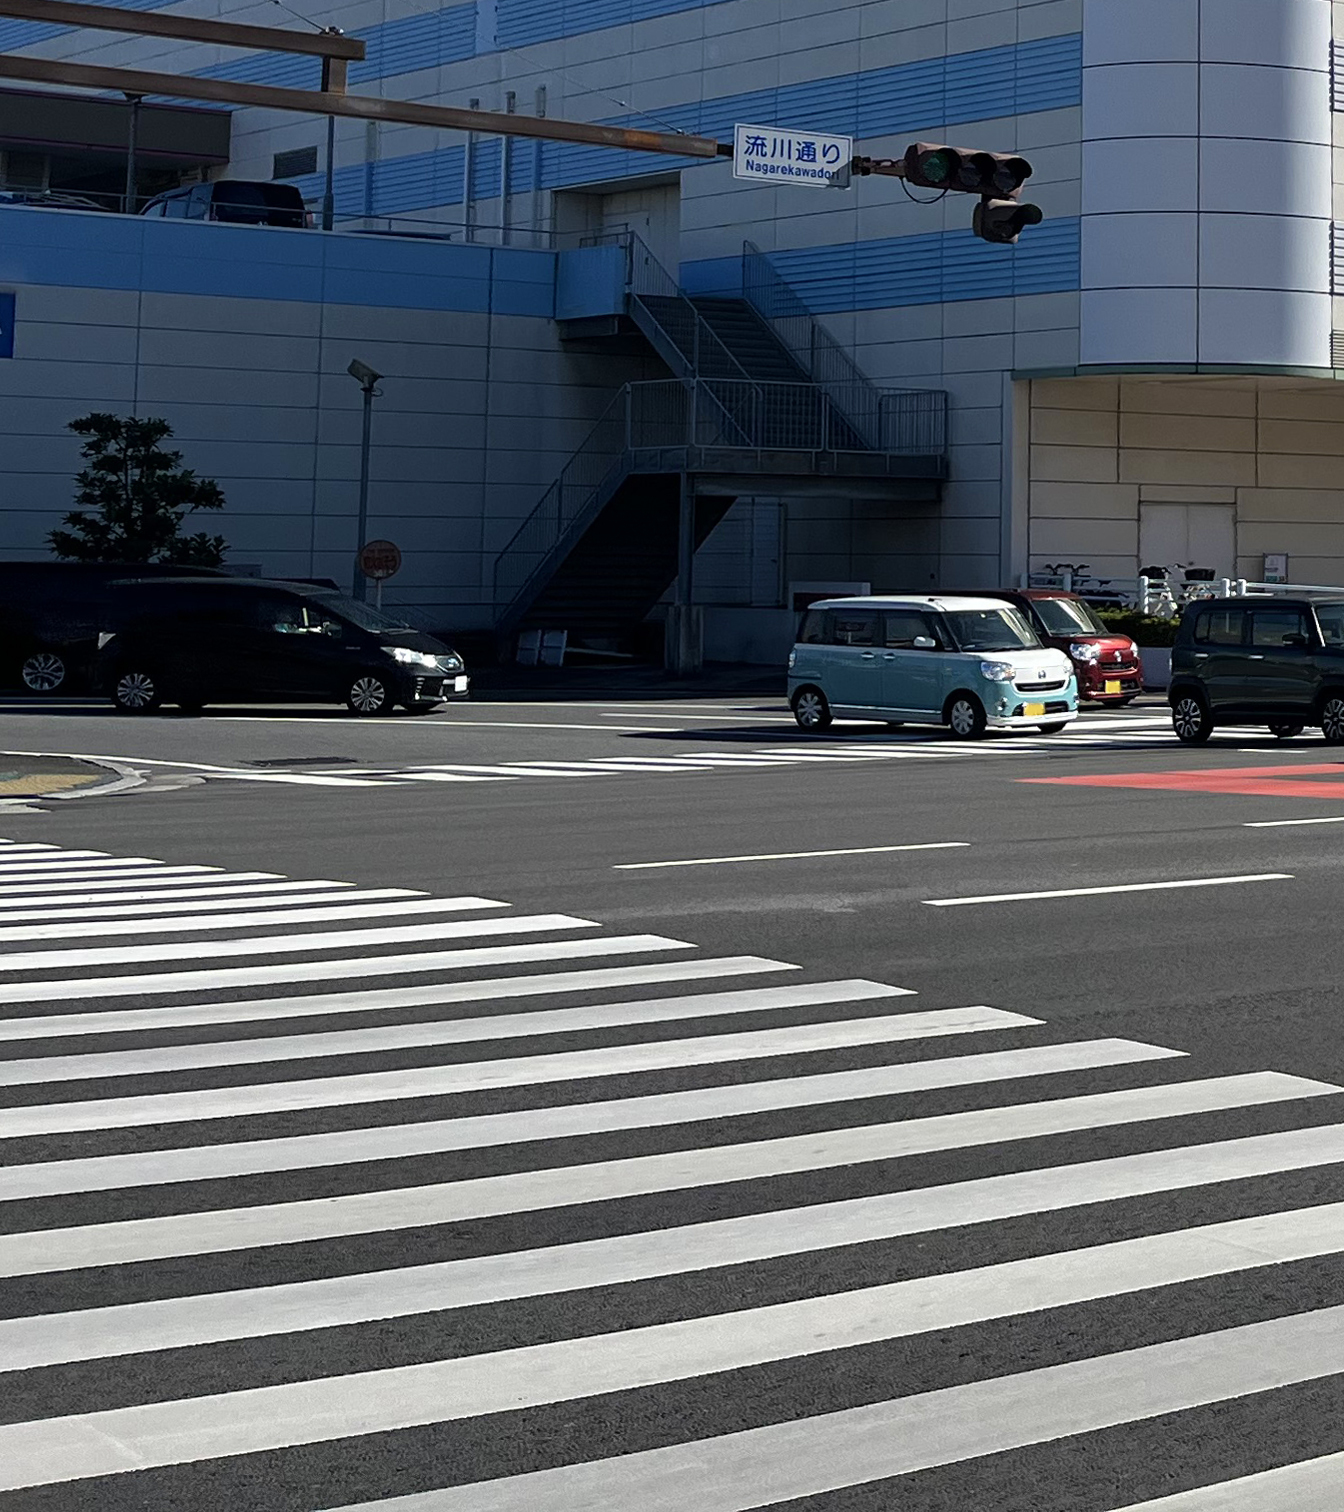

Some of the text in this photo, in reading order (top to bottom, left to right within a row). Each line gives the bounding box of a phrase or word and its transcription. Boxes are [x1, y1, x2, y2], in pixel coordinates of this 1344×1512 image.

[743, 134, 841, 164] 流川通り
[745, 159, 840, 181] Nagarekawadori
